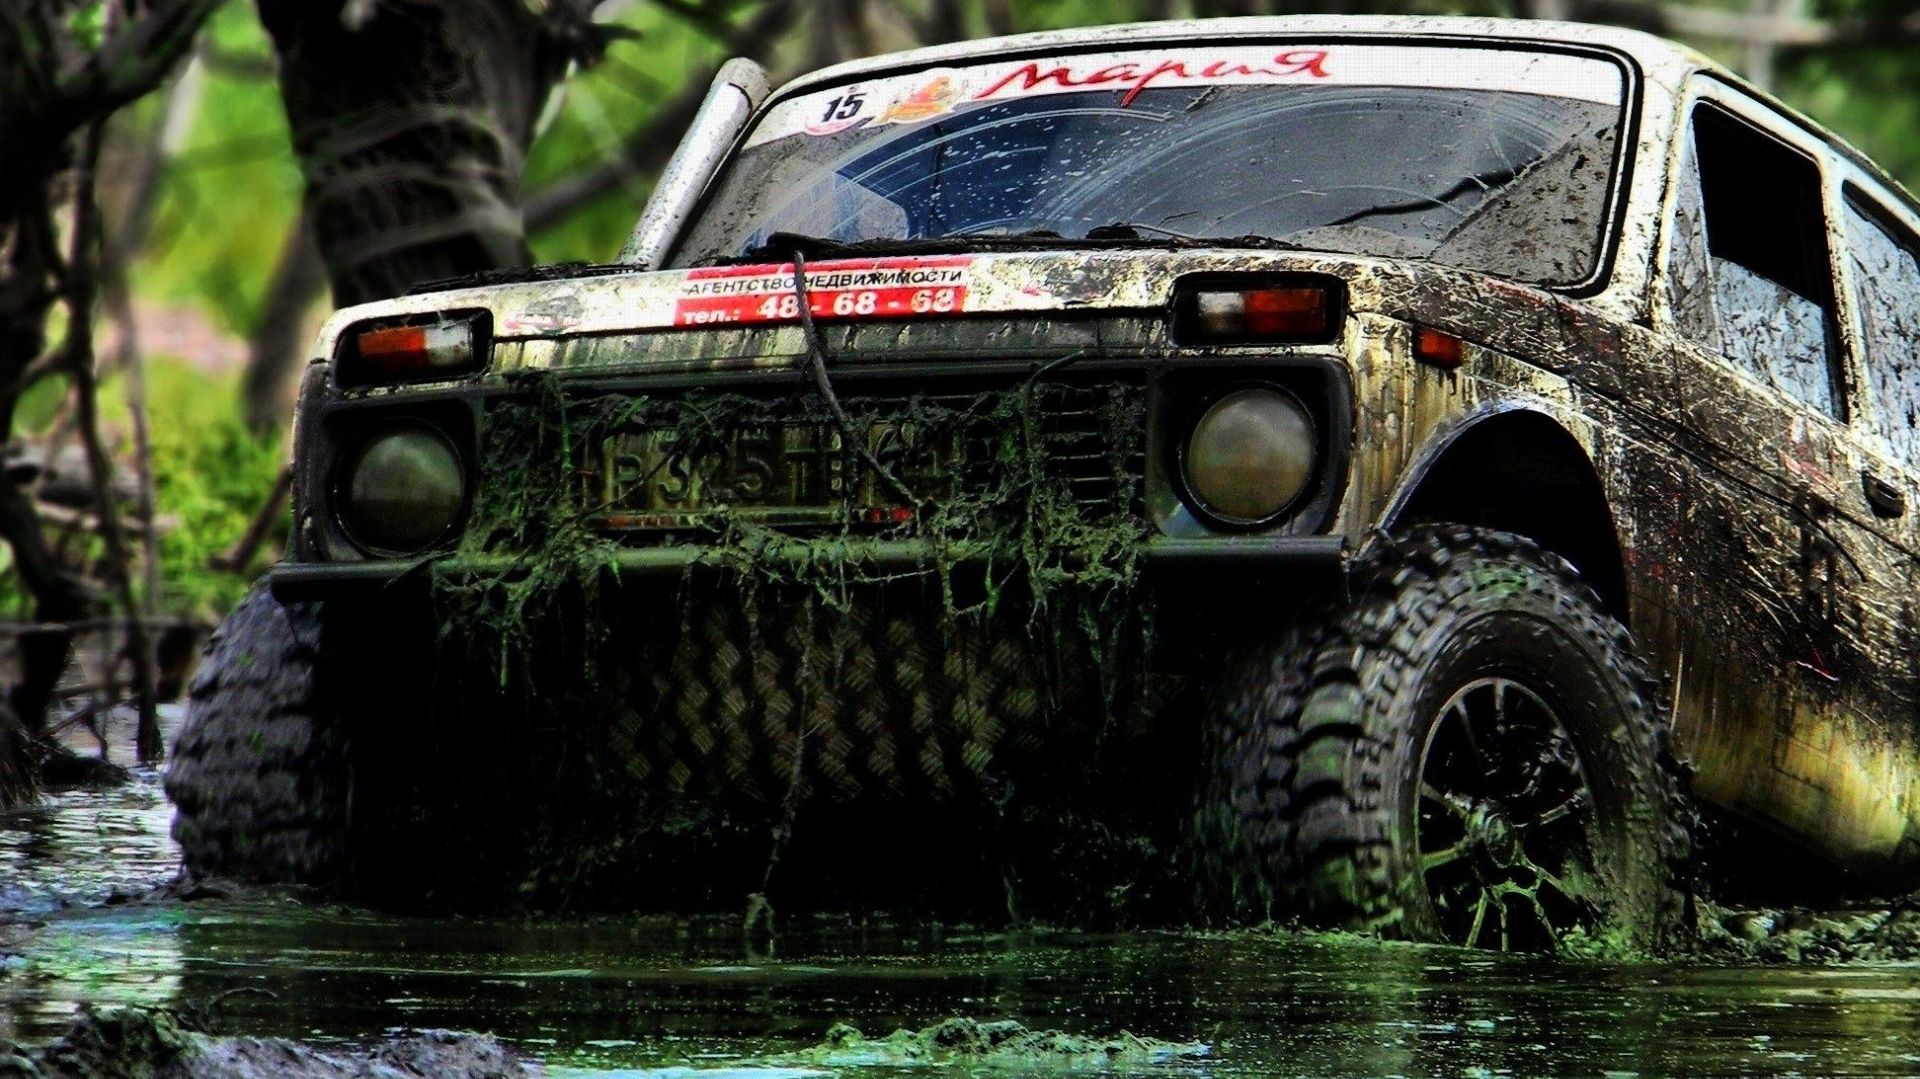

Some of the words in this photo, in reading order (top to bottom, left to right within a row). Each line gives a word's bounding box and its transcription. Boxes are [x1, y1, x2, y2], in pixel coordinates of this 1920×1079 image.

[822, 92, 867, 121] 15
[688, 277, 796, 297] АГЕНТСТВО
[803, 270, 962, 288] НЕДВИЖИМОСТИ
[757, 295, 800, 319] 48
[833, 291, 877, 316] 68
